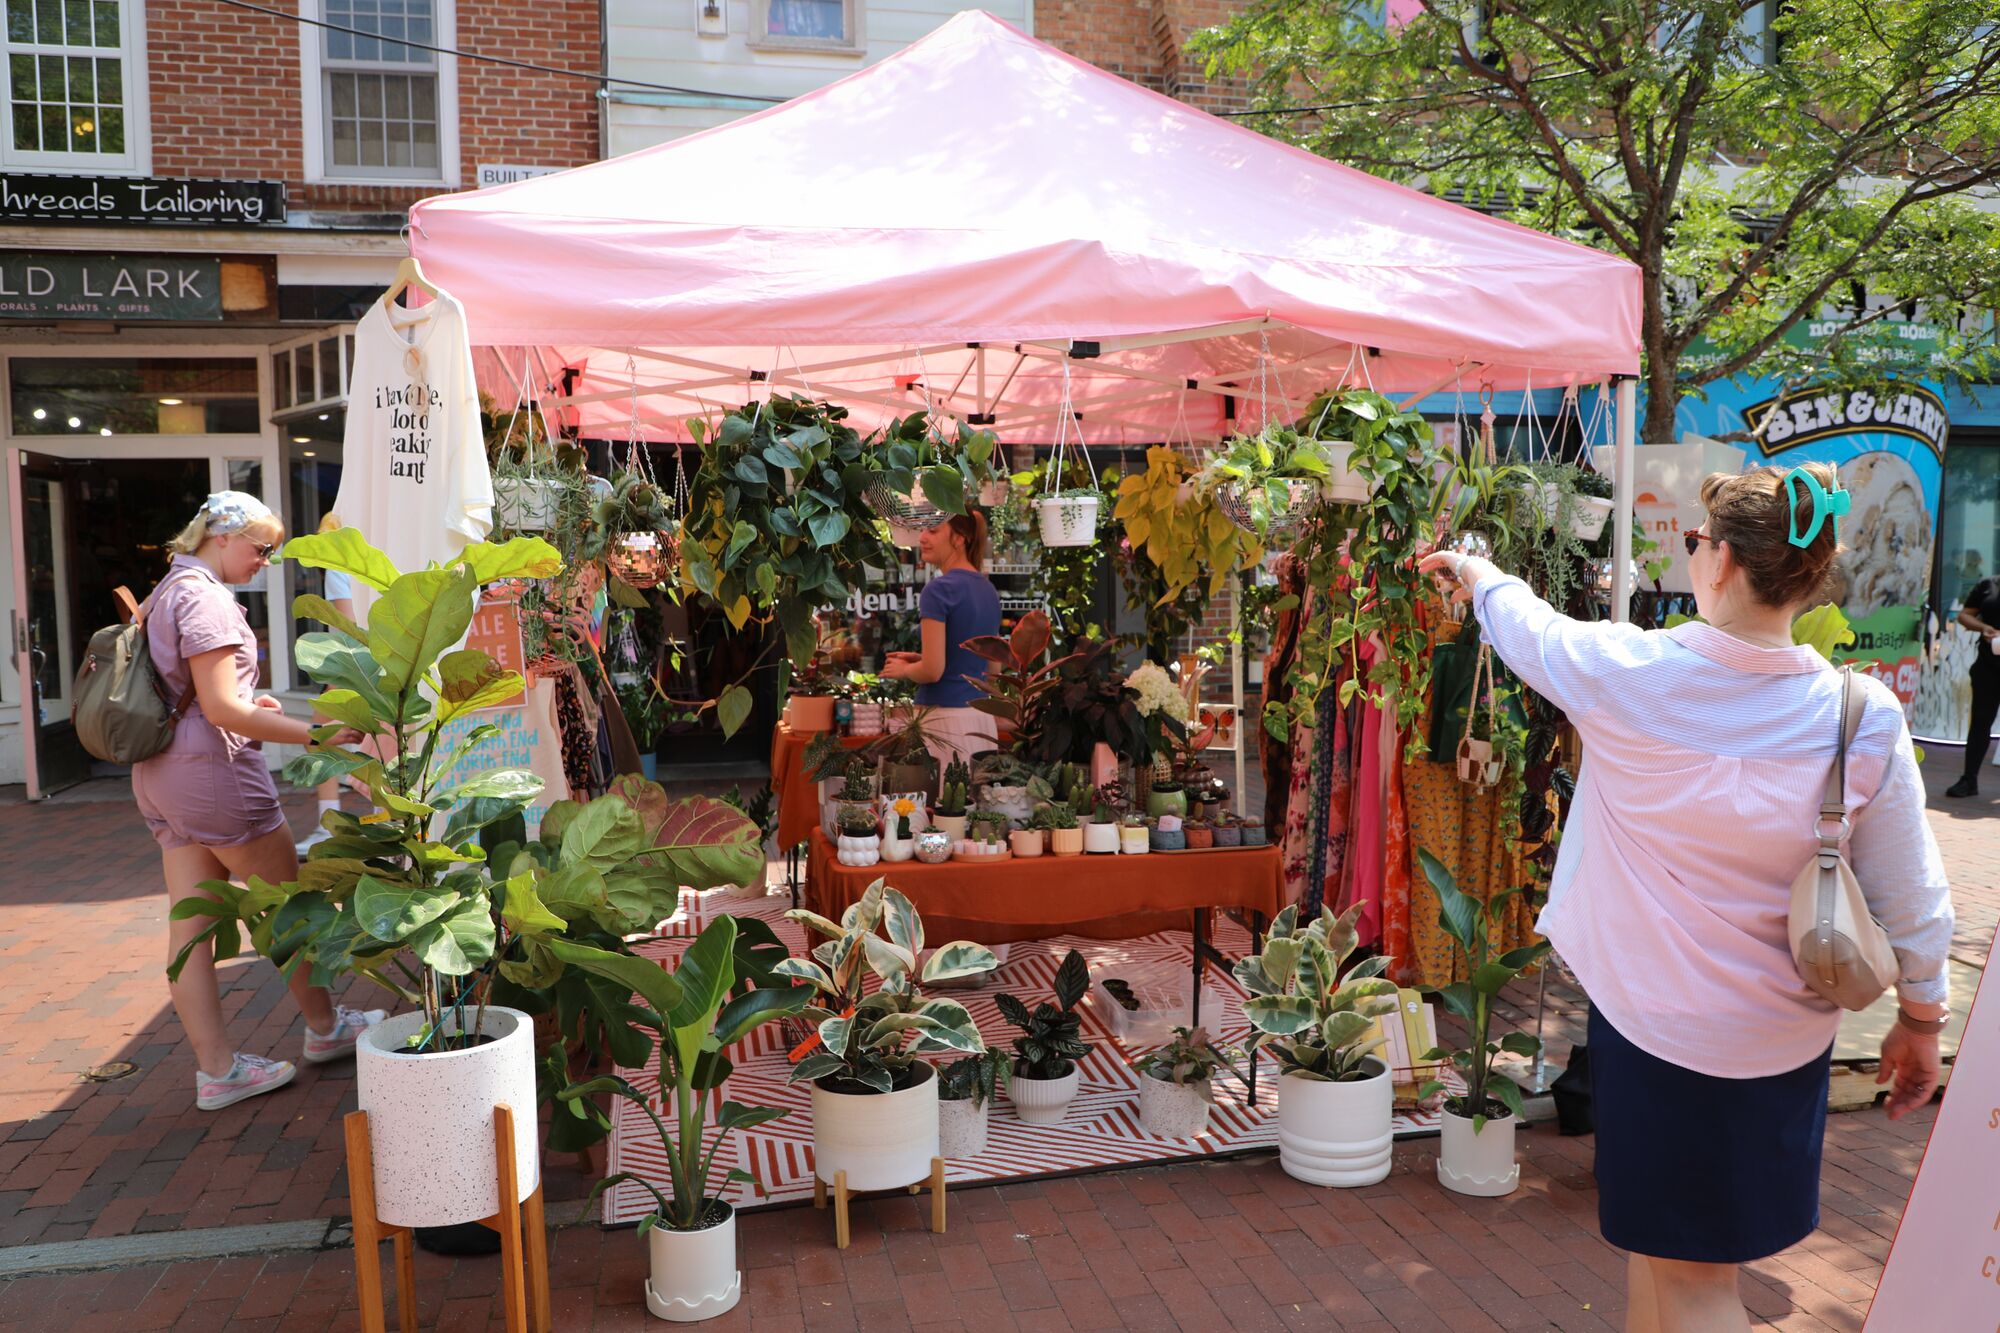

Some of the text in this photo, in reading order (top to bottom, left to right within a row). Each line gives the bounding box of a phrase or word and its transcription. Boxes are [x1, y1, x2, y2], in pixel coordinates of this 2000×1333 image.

[484, 169, 532, 184] BUILT
[0, 178, 263, 220] hreads Tailoring
[83, 267, 202, 298] LARK
[56, 303, 99, 312] PLANTS
[118, 304, 150, 313] GIFTS
[393, 407, 416, 430] lot
[468, 614, 505, 637] ALE
